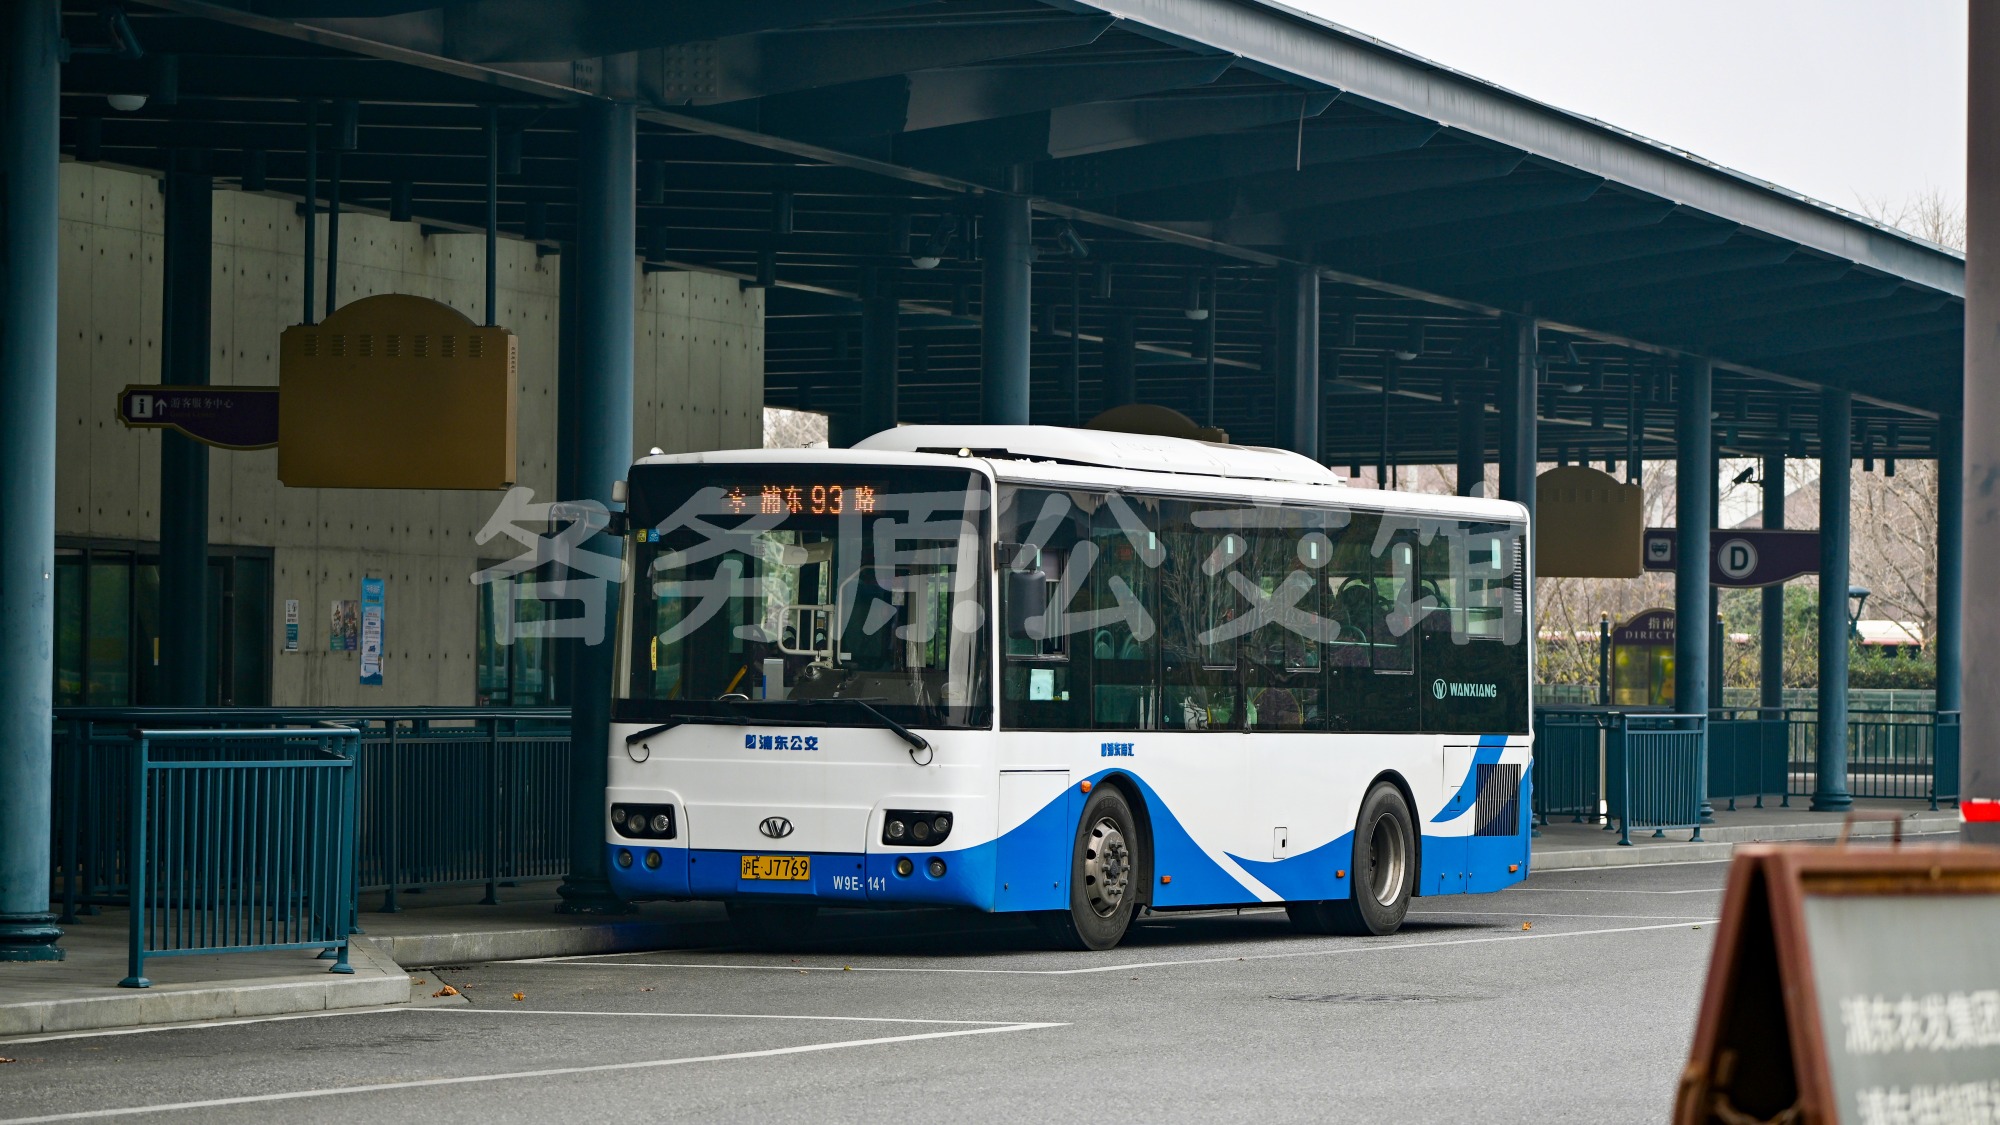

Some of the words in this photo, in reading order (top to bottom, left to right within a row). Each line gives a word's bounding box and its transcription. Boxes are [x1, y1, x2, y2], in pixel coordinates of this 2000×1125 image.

[1729, 546, 1749, 571] D
[1450, 683, 1497, 698] WANXIANG
[759, 735, 819, 751] 浦东公交
